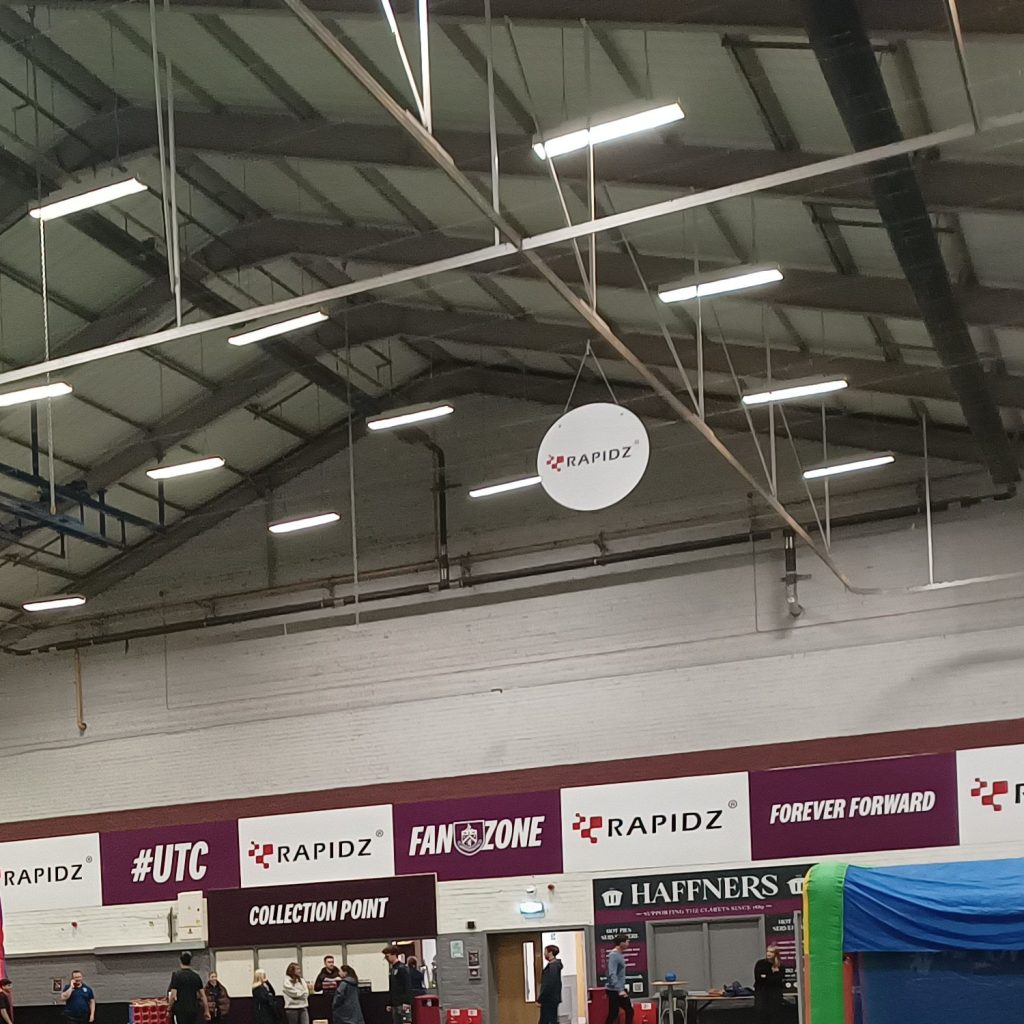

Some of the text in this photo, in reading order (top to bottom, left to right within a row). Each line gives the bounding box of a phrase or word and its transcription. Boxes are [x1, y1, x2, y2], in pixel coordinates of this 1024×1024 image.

[567, 446, 632, 468] RAPIDZ
[770, 790, 936, 825] FOREVER FORWARD
[409, 815, 546, 857] FAN ZONE
[607, 809, 723, 838] RAPIDZ
[131, 840, 209, 884] #UTC
[277, 838, 372, 864] RAPIDZ
[4, 864, 83, 887] RAPIDZ
[630, 874, 779, 905] HAFFNERS
[249, 896, 389, 926] COLLECTION POINT
